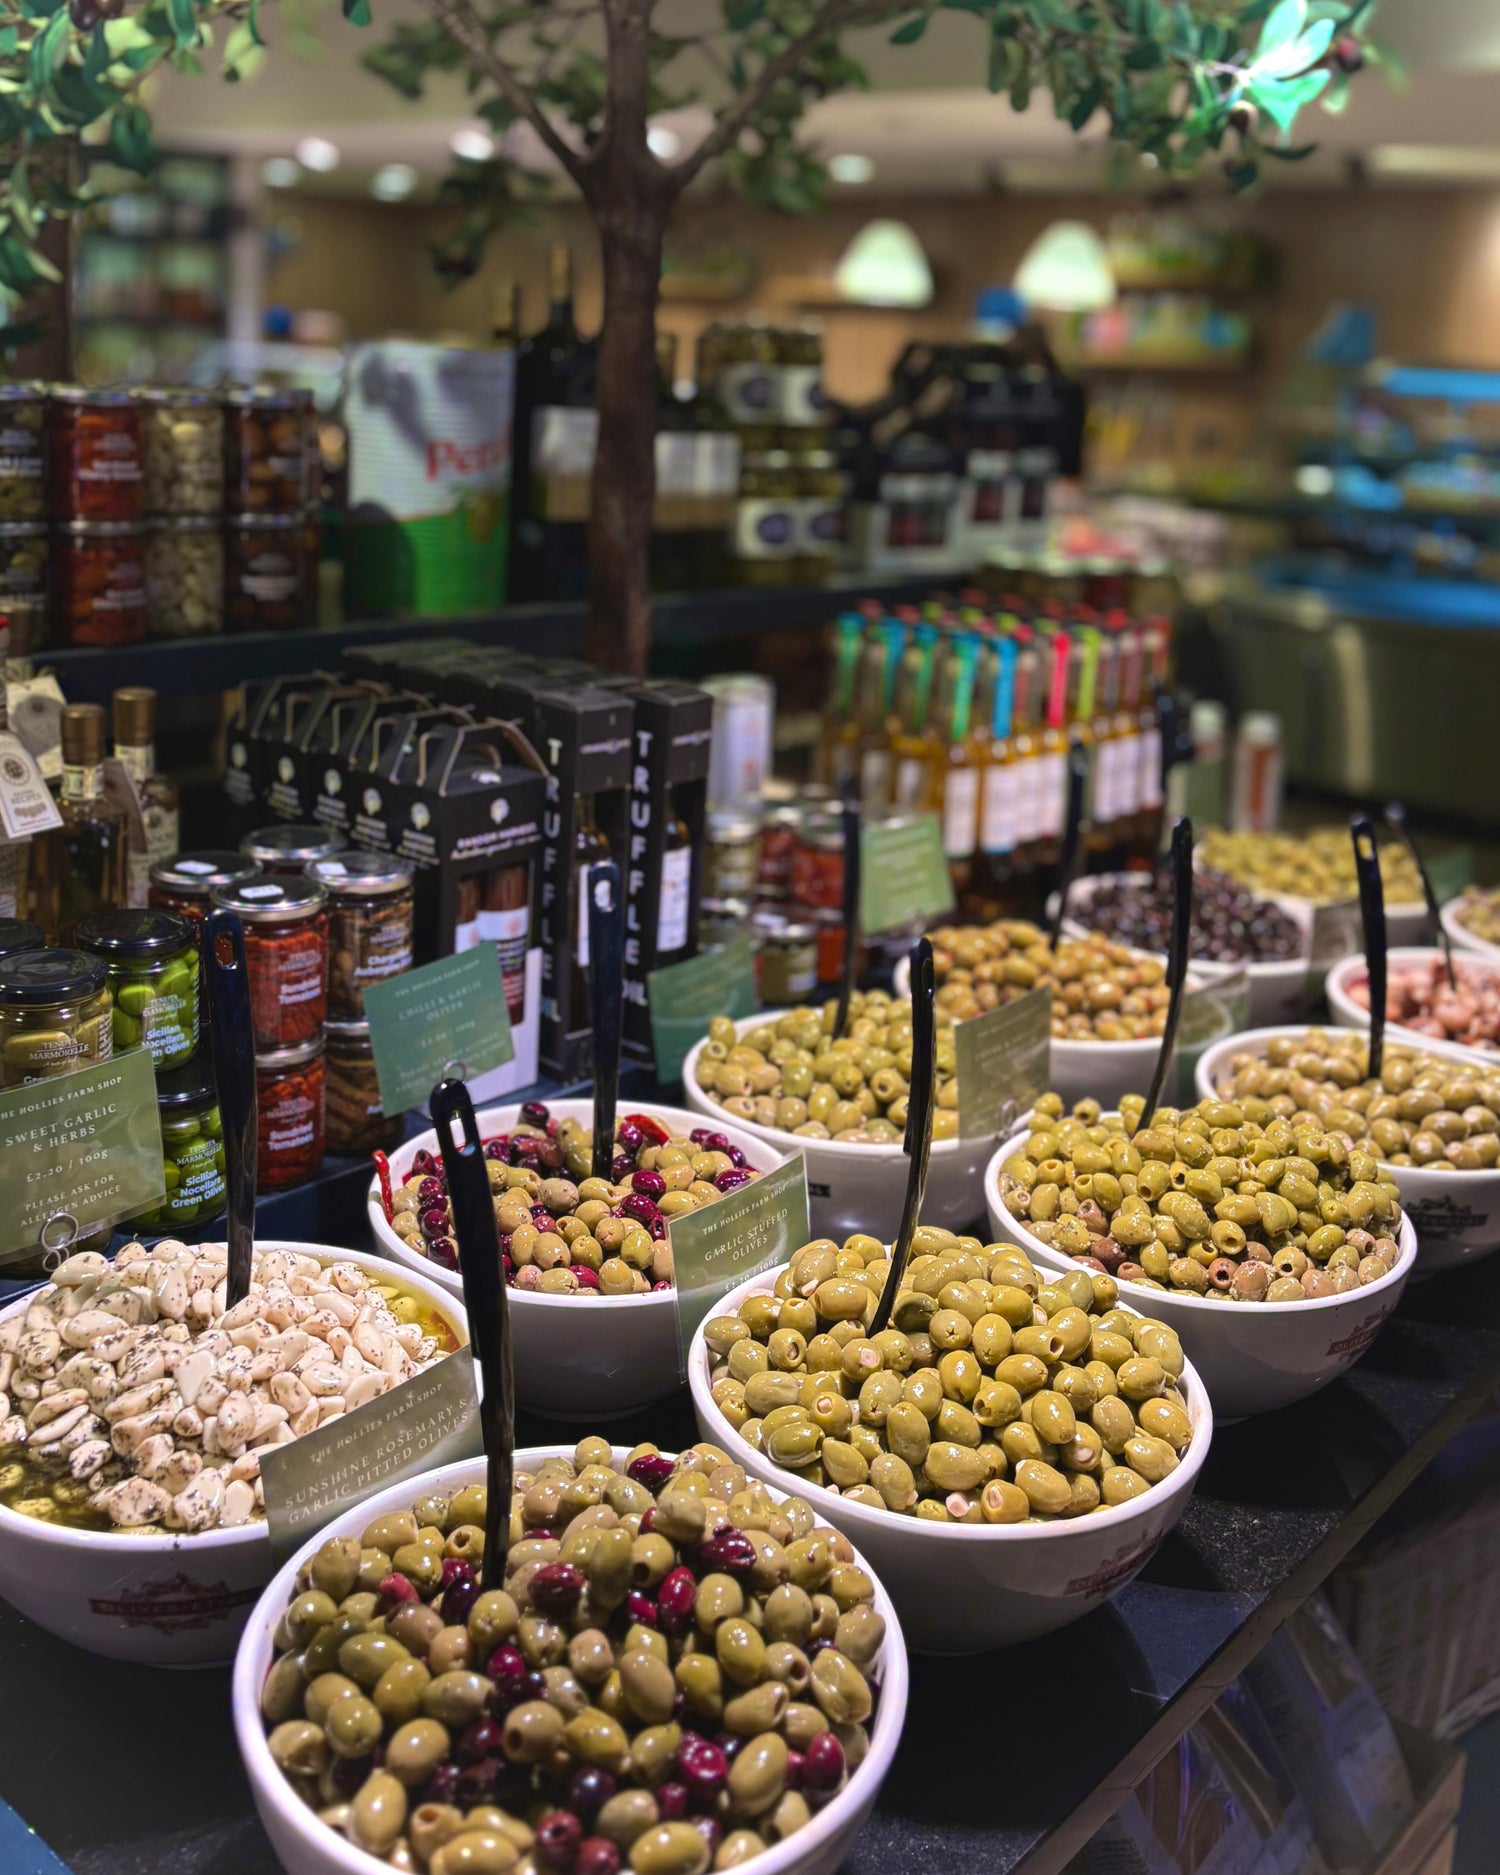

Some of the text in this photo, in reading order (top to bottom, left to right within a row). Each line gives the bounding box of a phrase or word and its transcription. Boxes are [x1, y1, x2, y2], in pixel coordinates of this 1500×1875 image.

[542, 738, 563, 980] TRUFFLE
[624, 730, 653, 966] TRUFFLE
[29, 1043, 90, 1060] MARMORELLE
[42, 1038, 78, 1050] TENUTA
[146, 1025, 181, 1040] Sicilian
[0, 1076, 122, 1120] HE HOLLIES FARM SHOP
[5, 1103, 117, 1147] SWEET GARLIC
[33, 1124, 96, 1153] & HERBS
[26, 1165, 63, 1183] £2.20
[79, 1149, 109, 1166] 100g
[186, 1169, 218, 1187] Sicilian
[20, 1184, 121, 1227] ALLERGEN ADVICE
[25, 1174, 115, 1211] PLEASE ASK FOR
[171, 1183, 225, 1209] Green Olives
[180, 1176, 222, 1198] Nocellara
[702, 1185, 787, 1236] THE HOLLIES FARM SHOP
[704, 1208, 789, 1262] GARLIC STUFFED
[732, 1234, 769, 1261] OLIVES
[309, 1383, 444, 1464] THE HOLLIES FARM SHOP
[285, 1397, 469, 1509] SUNSHINE ROSEMARY &
[289, 1411, 470, 1525] GARLIC PITTED OLIVES
